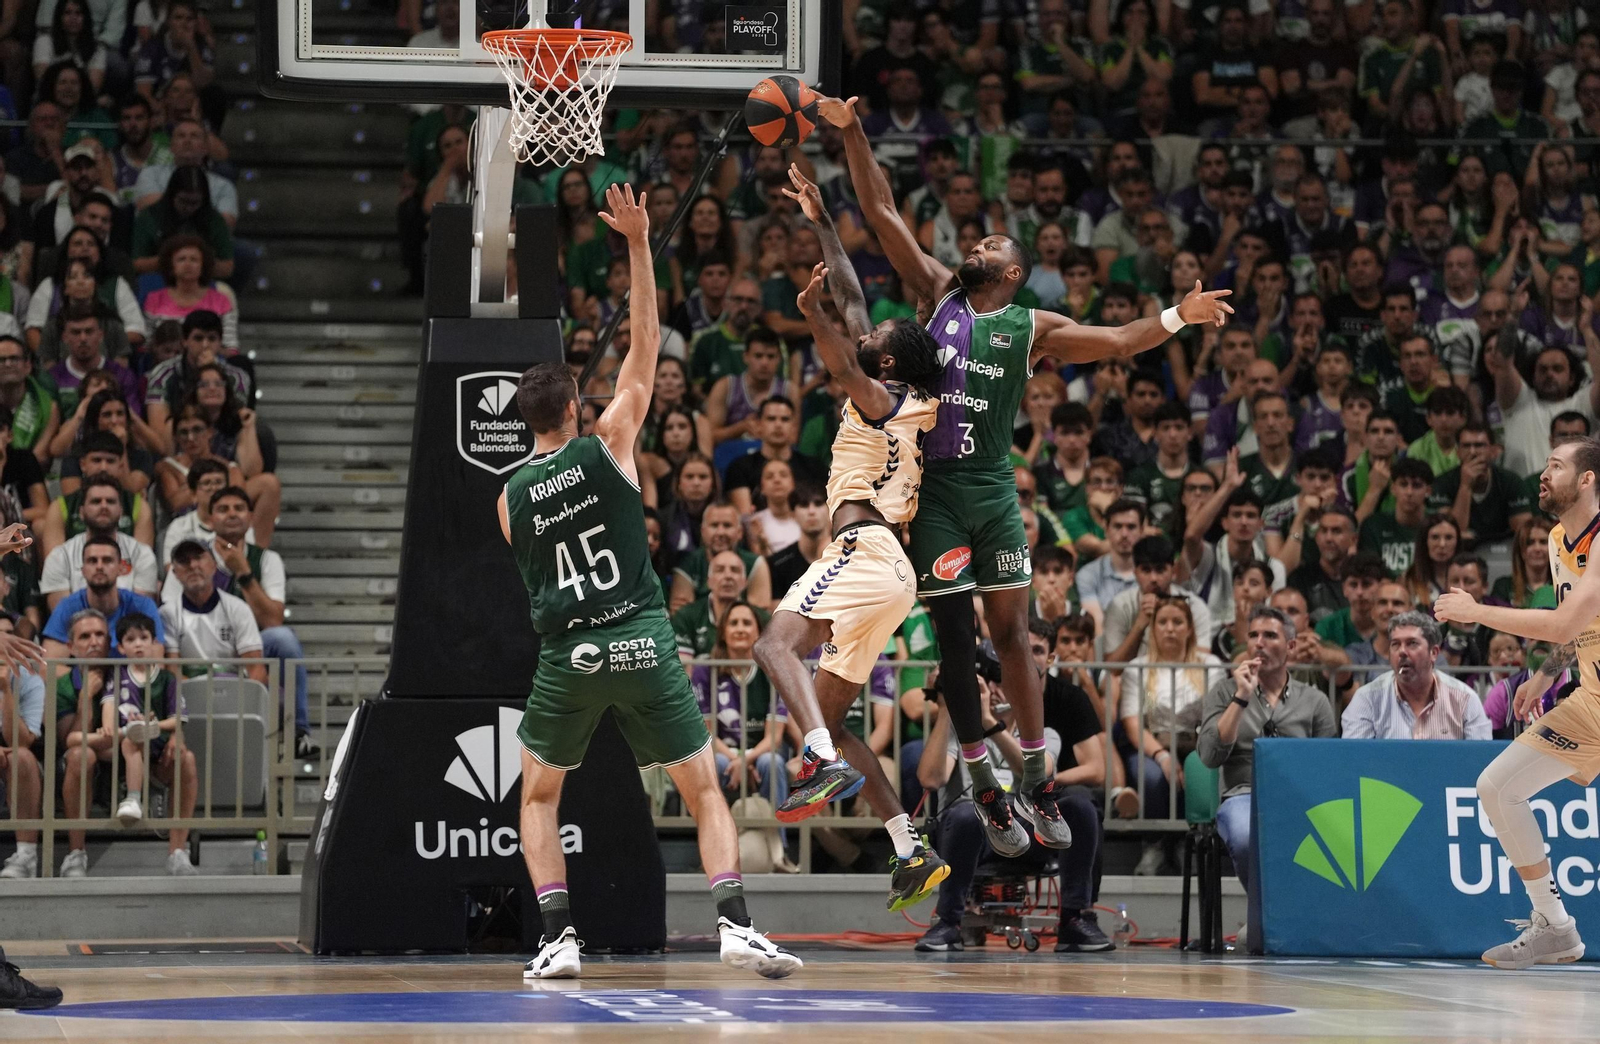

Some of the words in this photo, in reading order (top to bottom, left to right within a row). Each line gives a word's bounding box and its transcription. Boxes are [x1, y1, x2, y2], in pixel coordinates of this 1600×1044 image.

[733, 25, 773, 34] PLAYOFF
[955, 355, 1005, 380] Unicaja
[470, 419, 526, 431] Fundación
[478, 432, 519, 445] Unicaja
[957, 422, 976, 455] 3
[470, 443, 527, 452] Baloncesto
[528, 464, 586, 503] KRAVISH
[555, 523, 620, 602] 45
[608, 637, 657, 653] COSTA
[609, 652, 633, 663] DEL
[634, 649, 658, 660] SOL
[610, 659, 659, 673] MÁLAGA
